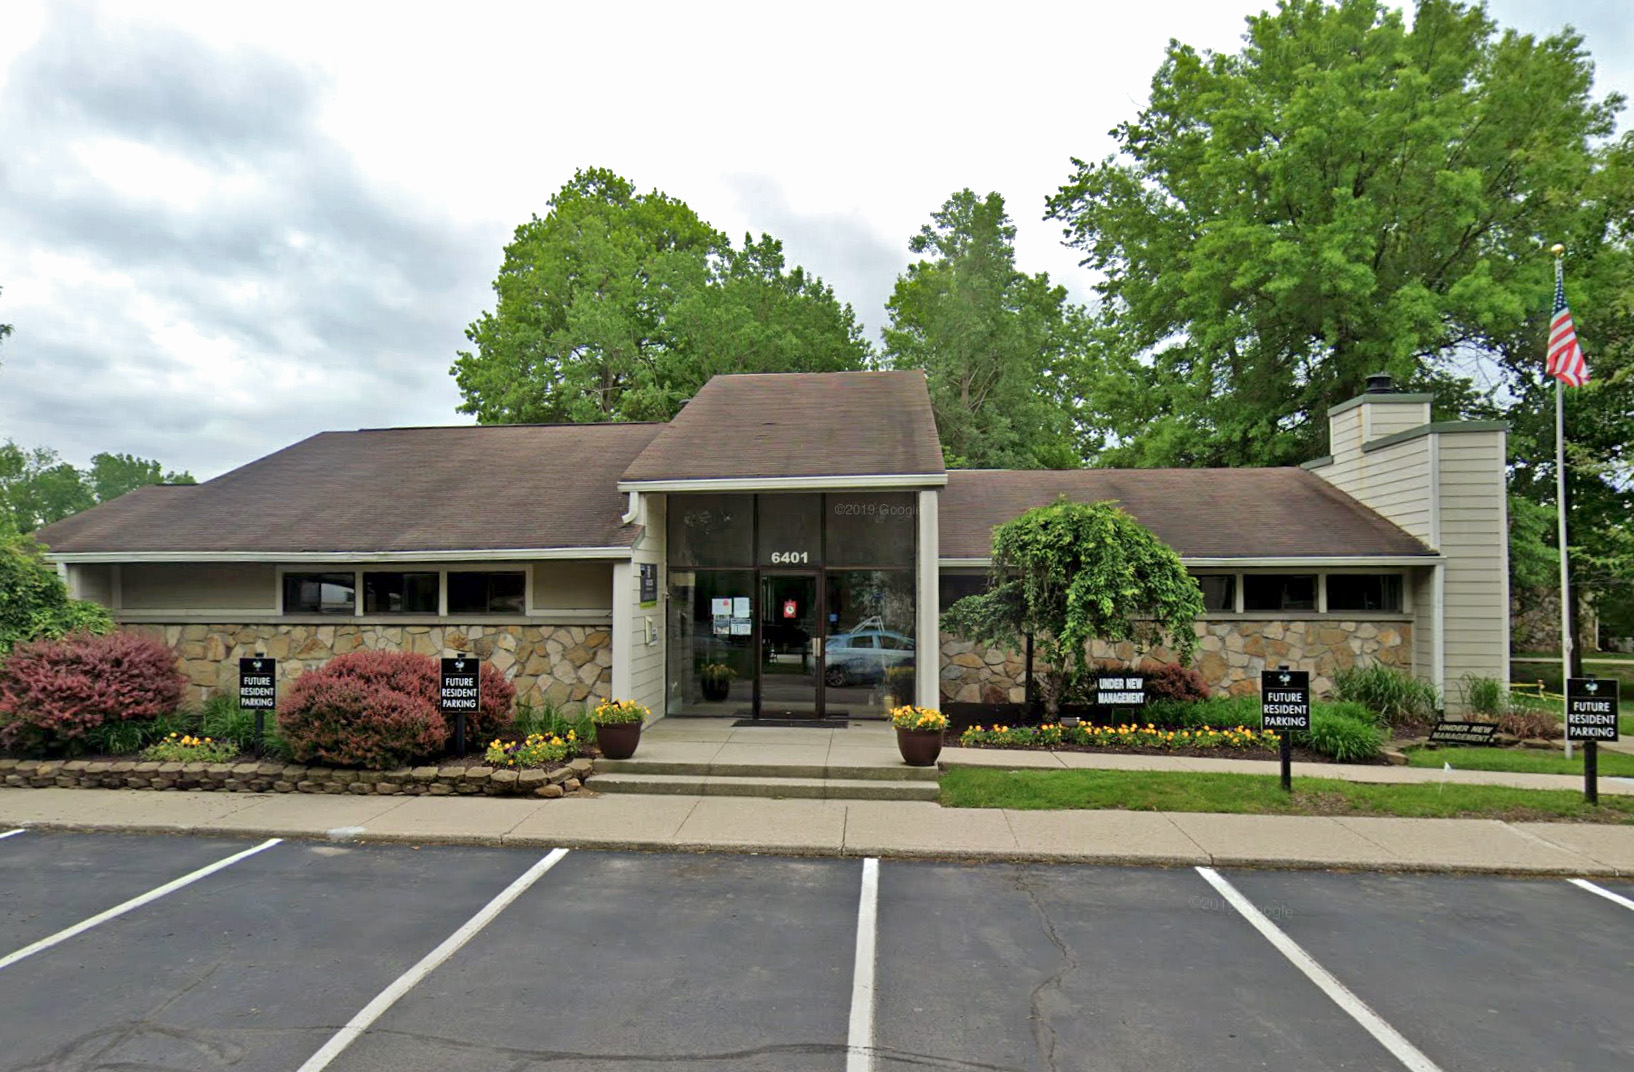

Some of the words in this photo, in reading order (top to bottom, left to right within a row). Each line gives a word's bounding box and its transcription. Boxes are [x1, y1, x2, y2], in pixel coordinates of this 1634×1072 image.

[771, 551, 808, 564] 6401
[243, 676, 271, 686] FUTURE
[445, 677, 474, 687] FUTURE
[1098, 677, 1125, 690] UNDER
[1126, 677, 1144, 690] NEW
[240, 687, 274, 696] RESIDENT
[441, 688, 477, 698] RESIDENT
[241, 697, 274, 707] PARKING
[442, 698, 477, 708] PARKING
[1098, 692, 1145, 704] MANAGEMENT
[1267, 692, 1303, 703] FUTURE
[1263, 704, 1308, 715] RESIDENT
[1573, 701, 1611, 713] FUTURE
[1264, 716, 1307, 727] PARKING
[1568, 713, 1616, 725] RESIDENT
[1438, 724, 1470, 732] UNDER
[1470, 725, 1495, 734] NEW
[1570, 726, 1615, 738] PARKING
